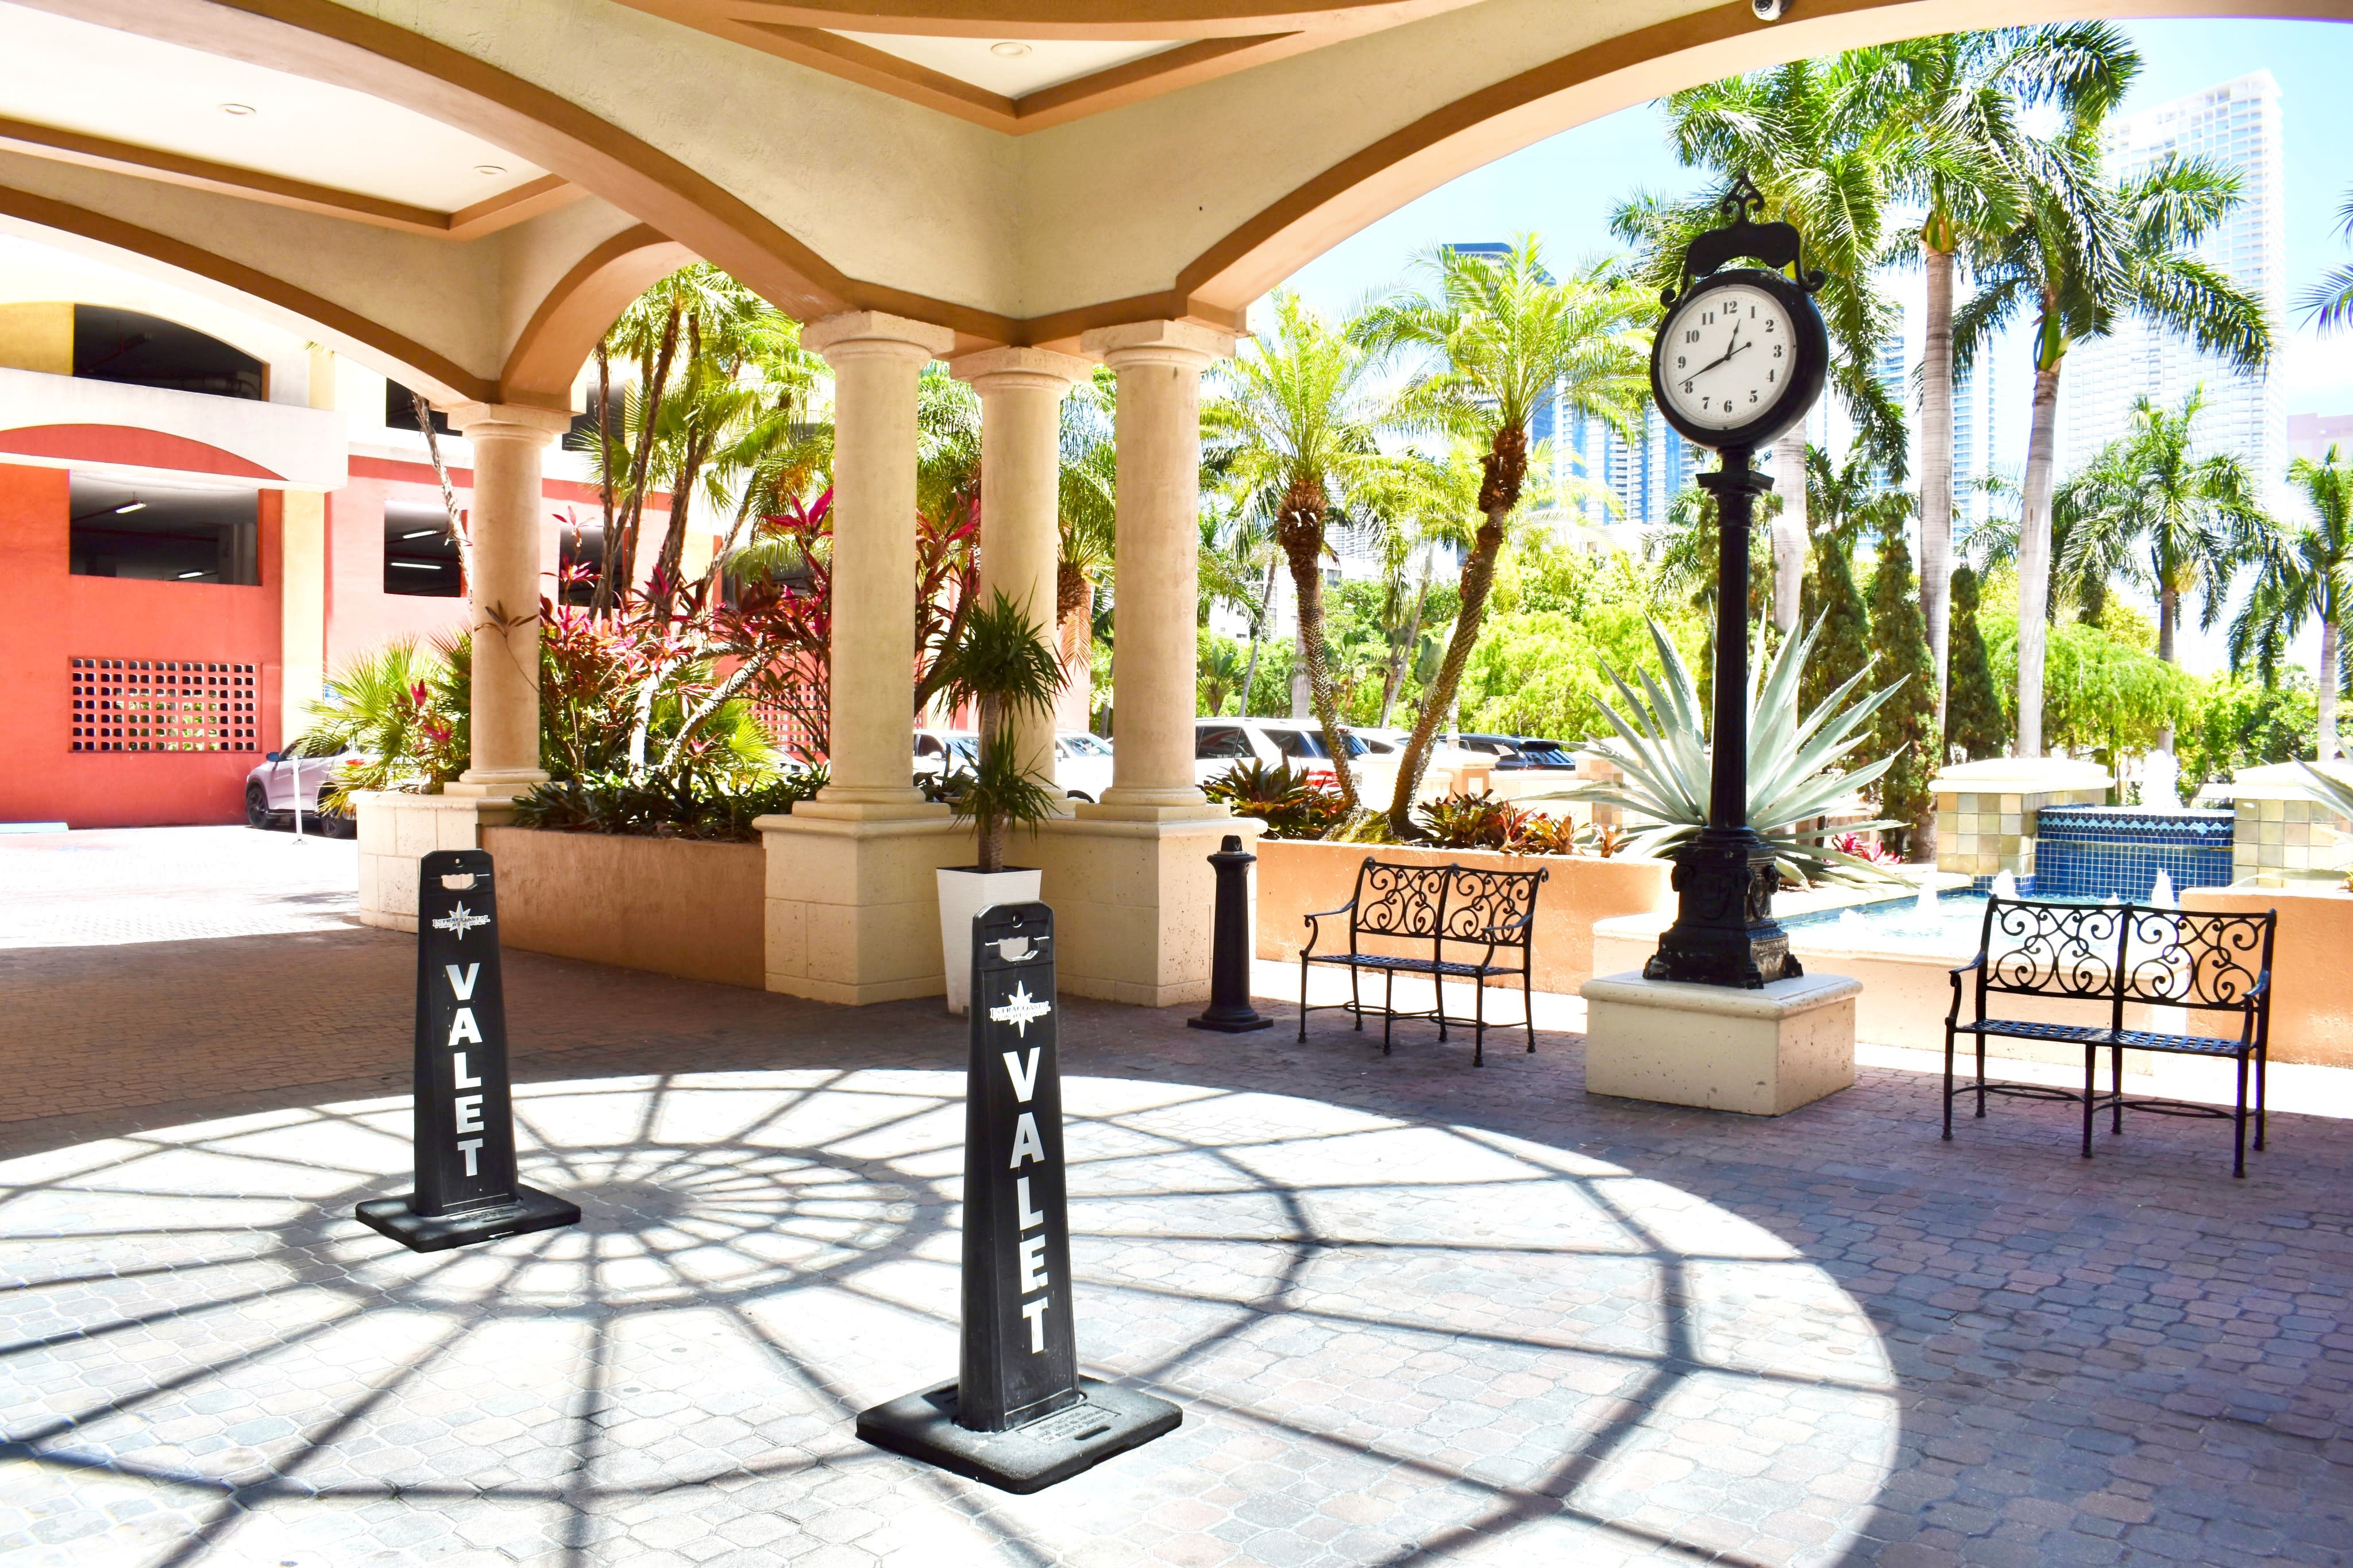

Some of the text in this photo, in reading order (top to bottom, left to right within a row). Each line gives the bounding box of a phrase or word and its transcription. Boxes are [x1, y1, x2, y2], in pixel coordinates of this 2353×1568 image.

[1723, 301, 1738, 315] 12
[1750, 306, 1756, 319] 1
[1702, 312, 1714, 325] 11
[1765, 320, 1774, 333] 2
[1685, 330, 1700, 343] 10
[1773, 345, 1782, 358] 3
[1678, 356, 1686, 369] 9
[1766, 369, 1775, 382] 4
[1685, 381, 1693, 394] 8
[1749, 390, 1758, 403] 5
[1702, 397, 1710, 410] 7
[1724, 400, 1733, 413] 6
[446, 963, 484, 1176] VALET
[1002, 1046, 1048, 1354] VALET
